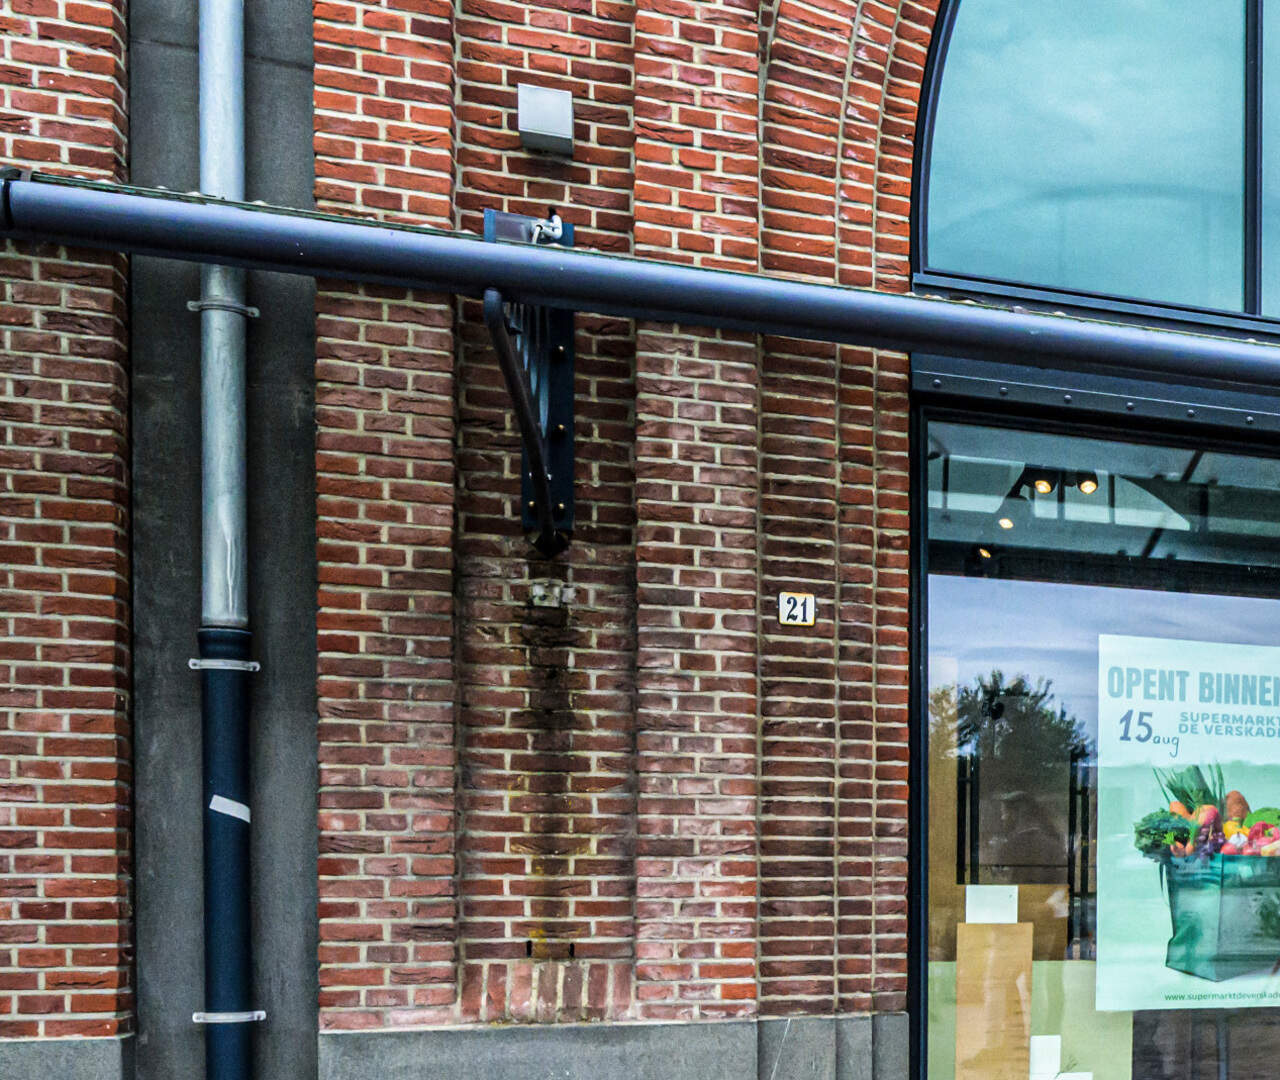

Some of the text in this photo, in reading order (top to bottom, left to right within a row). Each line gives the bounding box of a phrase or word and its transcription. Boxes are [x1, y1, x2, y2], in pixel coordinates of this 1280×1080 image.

[786, 596, 808, 623] 21
[1107, 666, 1190, 702] OPENT
[1119, 709, 1180, 758] 15 aug
[1178, 723, 1199, 735] DE
